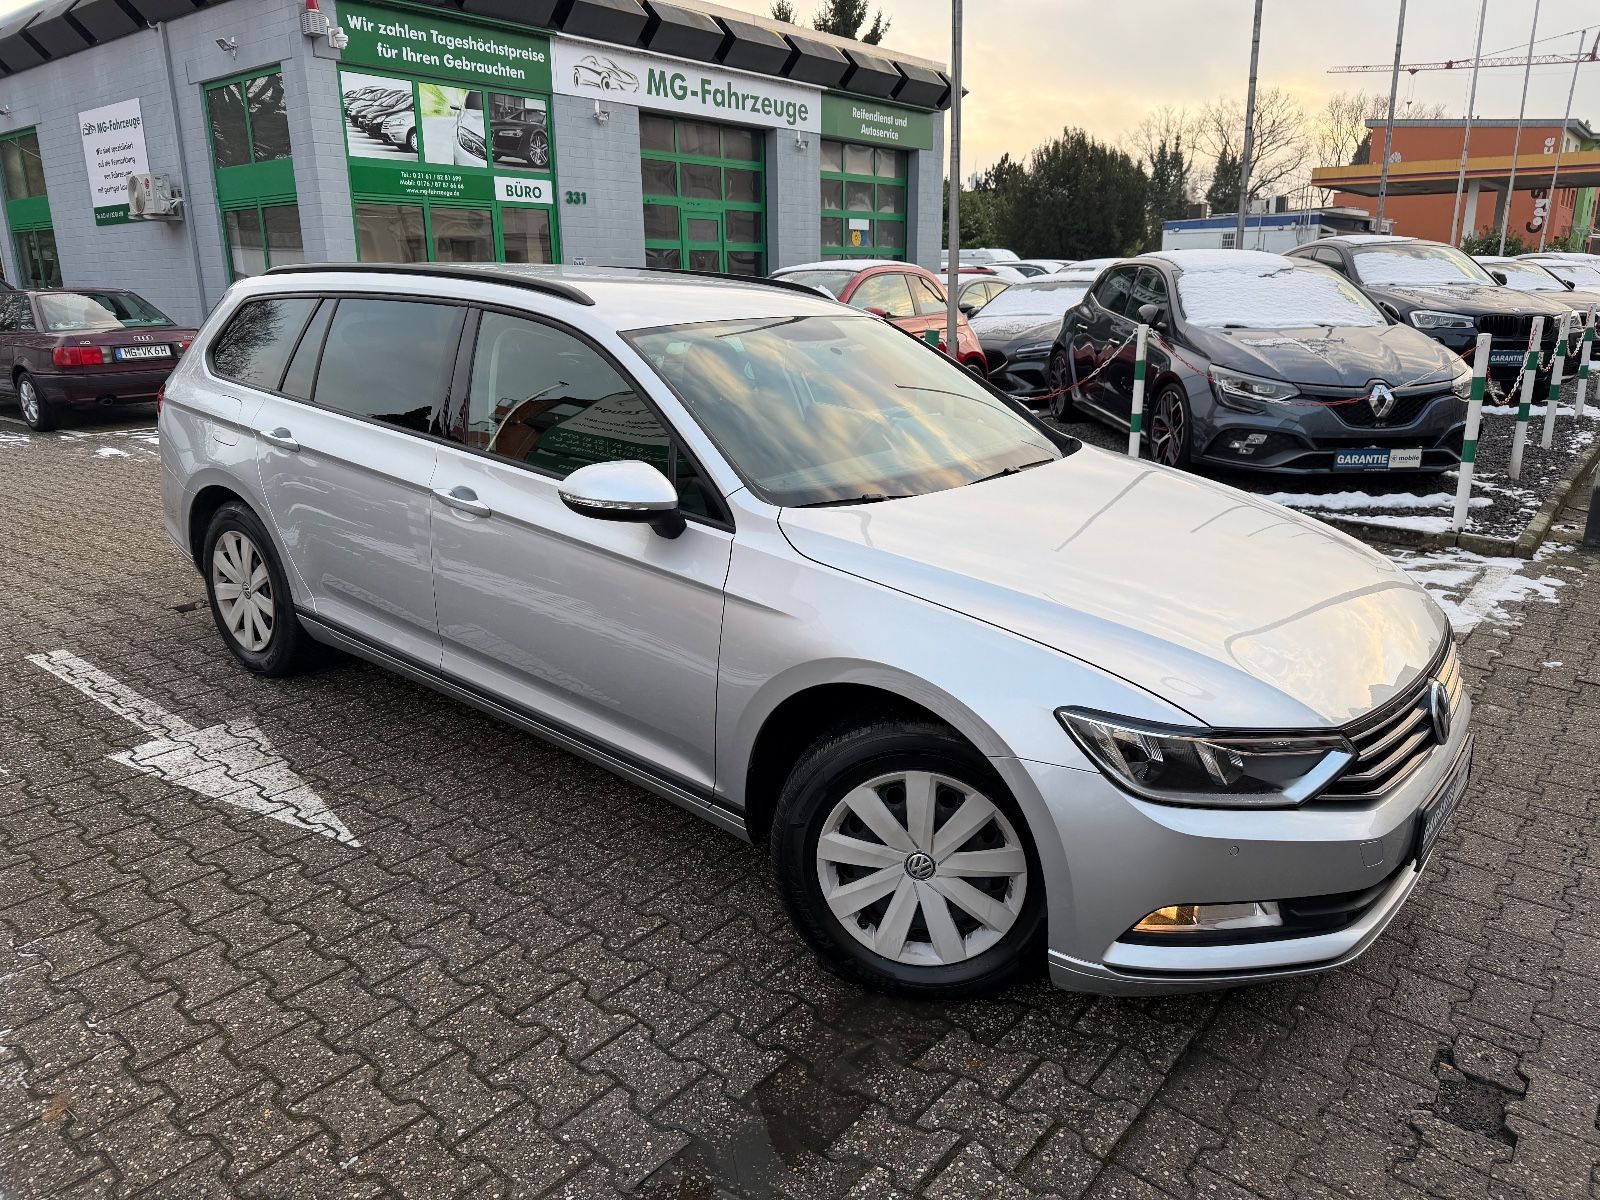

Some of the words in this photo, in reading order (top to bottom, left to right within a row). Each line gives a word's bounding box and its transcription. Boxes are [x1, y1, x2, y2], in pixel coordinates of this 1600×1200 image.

[346, 14, 374, 32] Wir
[378, 22, 427, 42] zahlen
[430, 29, 545, 63] Tageshöchstpreise
[376, 41, 398, 59] für
[402, 46, 440, 66] Ihren
[443, 53, 526, 80] Gebrauchten
[646, 67, 809, 126] MG-Fahrzeuge
[96, 116, 141, 134] MG-Fahrzeuge
[852, 106, 894, 125] Reifendienst
[895, 117, 908, 128] und
[860, 123, 899, 140] Autoservice
[505, 181, 542, 199] BÜRO
[565, 190, 587, 205] 331
[123, 348, 138, 358] MG
[141, 346, 152, 356] VK
[1490, 354, 1524, 362] GARANTIE
[1336, 454, 1389, 464] GARANTIE
